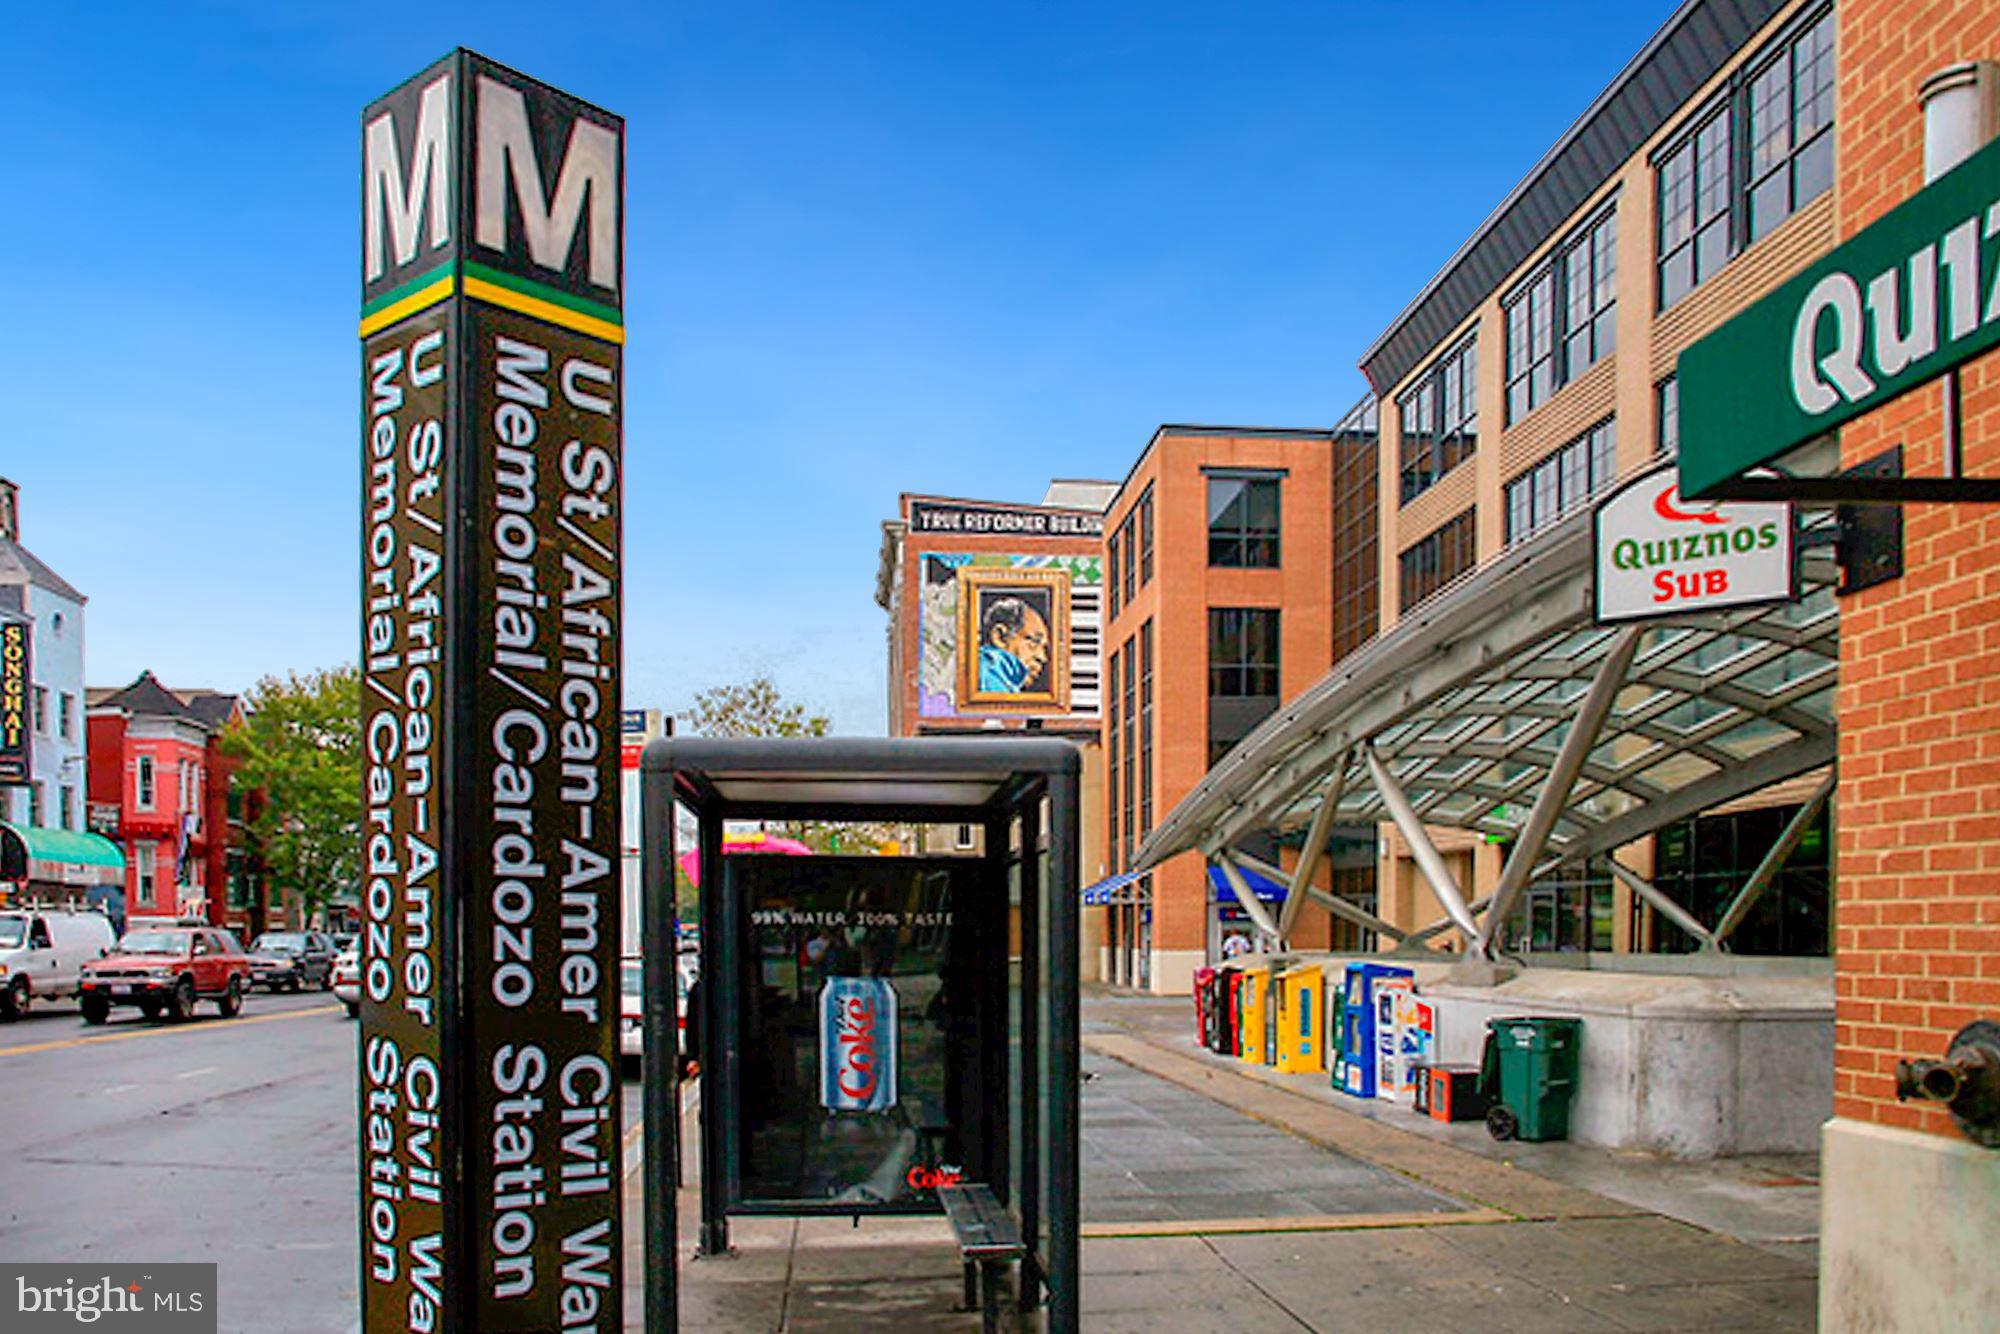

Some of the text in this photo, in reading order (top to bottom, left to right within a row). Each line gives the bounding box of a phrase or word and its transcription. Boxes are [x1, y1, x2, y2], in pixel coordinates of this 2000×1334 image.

[366, 74, 450, 285] M
[475, 73, 618, 292] M
[409, 330, 444, 388] U
[560, 356, 614, 417] U
[920, 510, 961, 530] TRUE
[963, 512, 1047, 533] REFORMER
[1612, 522, 1779, 570] Quiznos
[4, 625, 24, 747] SONGHAI
[405, 419, 442, 1026] St/African-Amer
[556, 438, 614, 1024] St/African-Amer
[366, 347, 405, 1284] Memorial/Cardozo Station
[489, 335, 551, 1299] Memorial/Cardozo Station
[838, 997, 877, 1098] Coke
[405, 1056, 442, 1204] Civil
[559, 1055, 612, 1196] Civil
[907, 1166, 962, 1190] Coke
